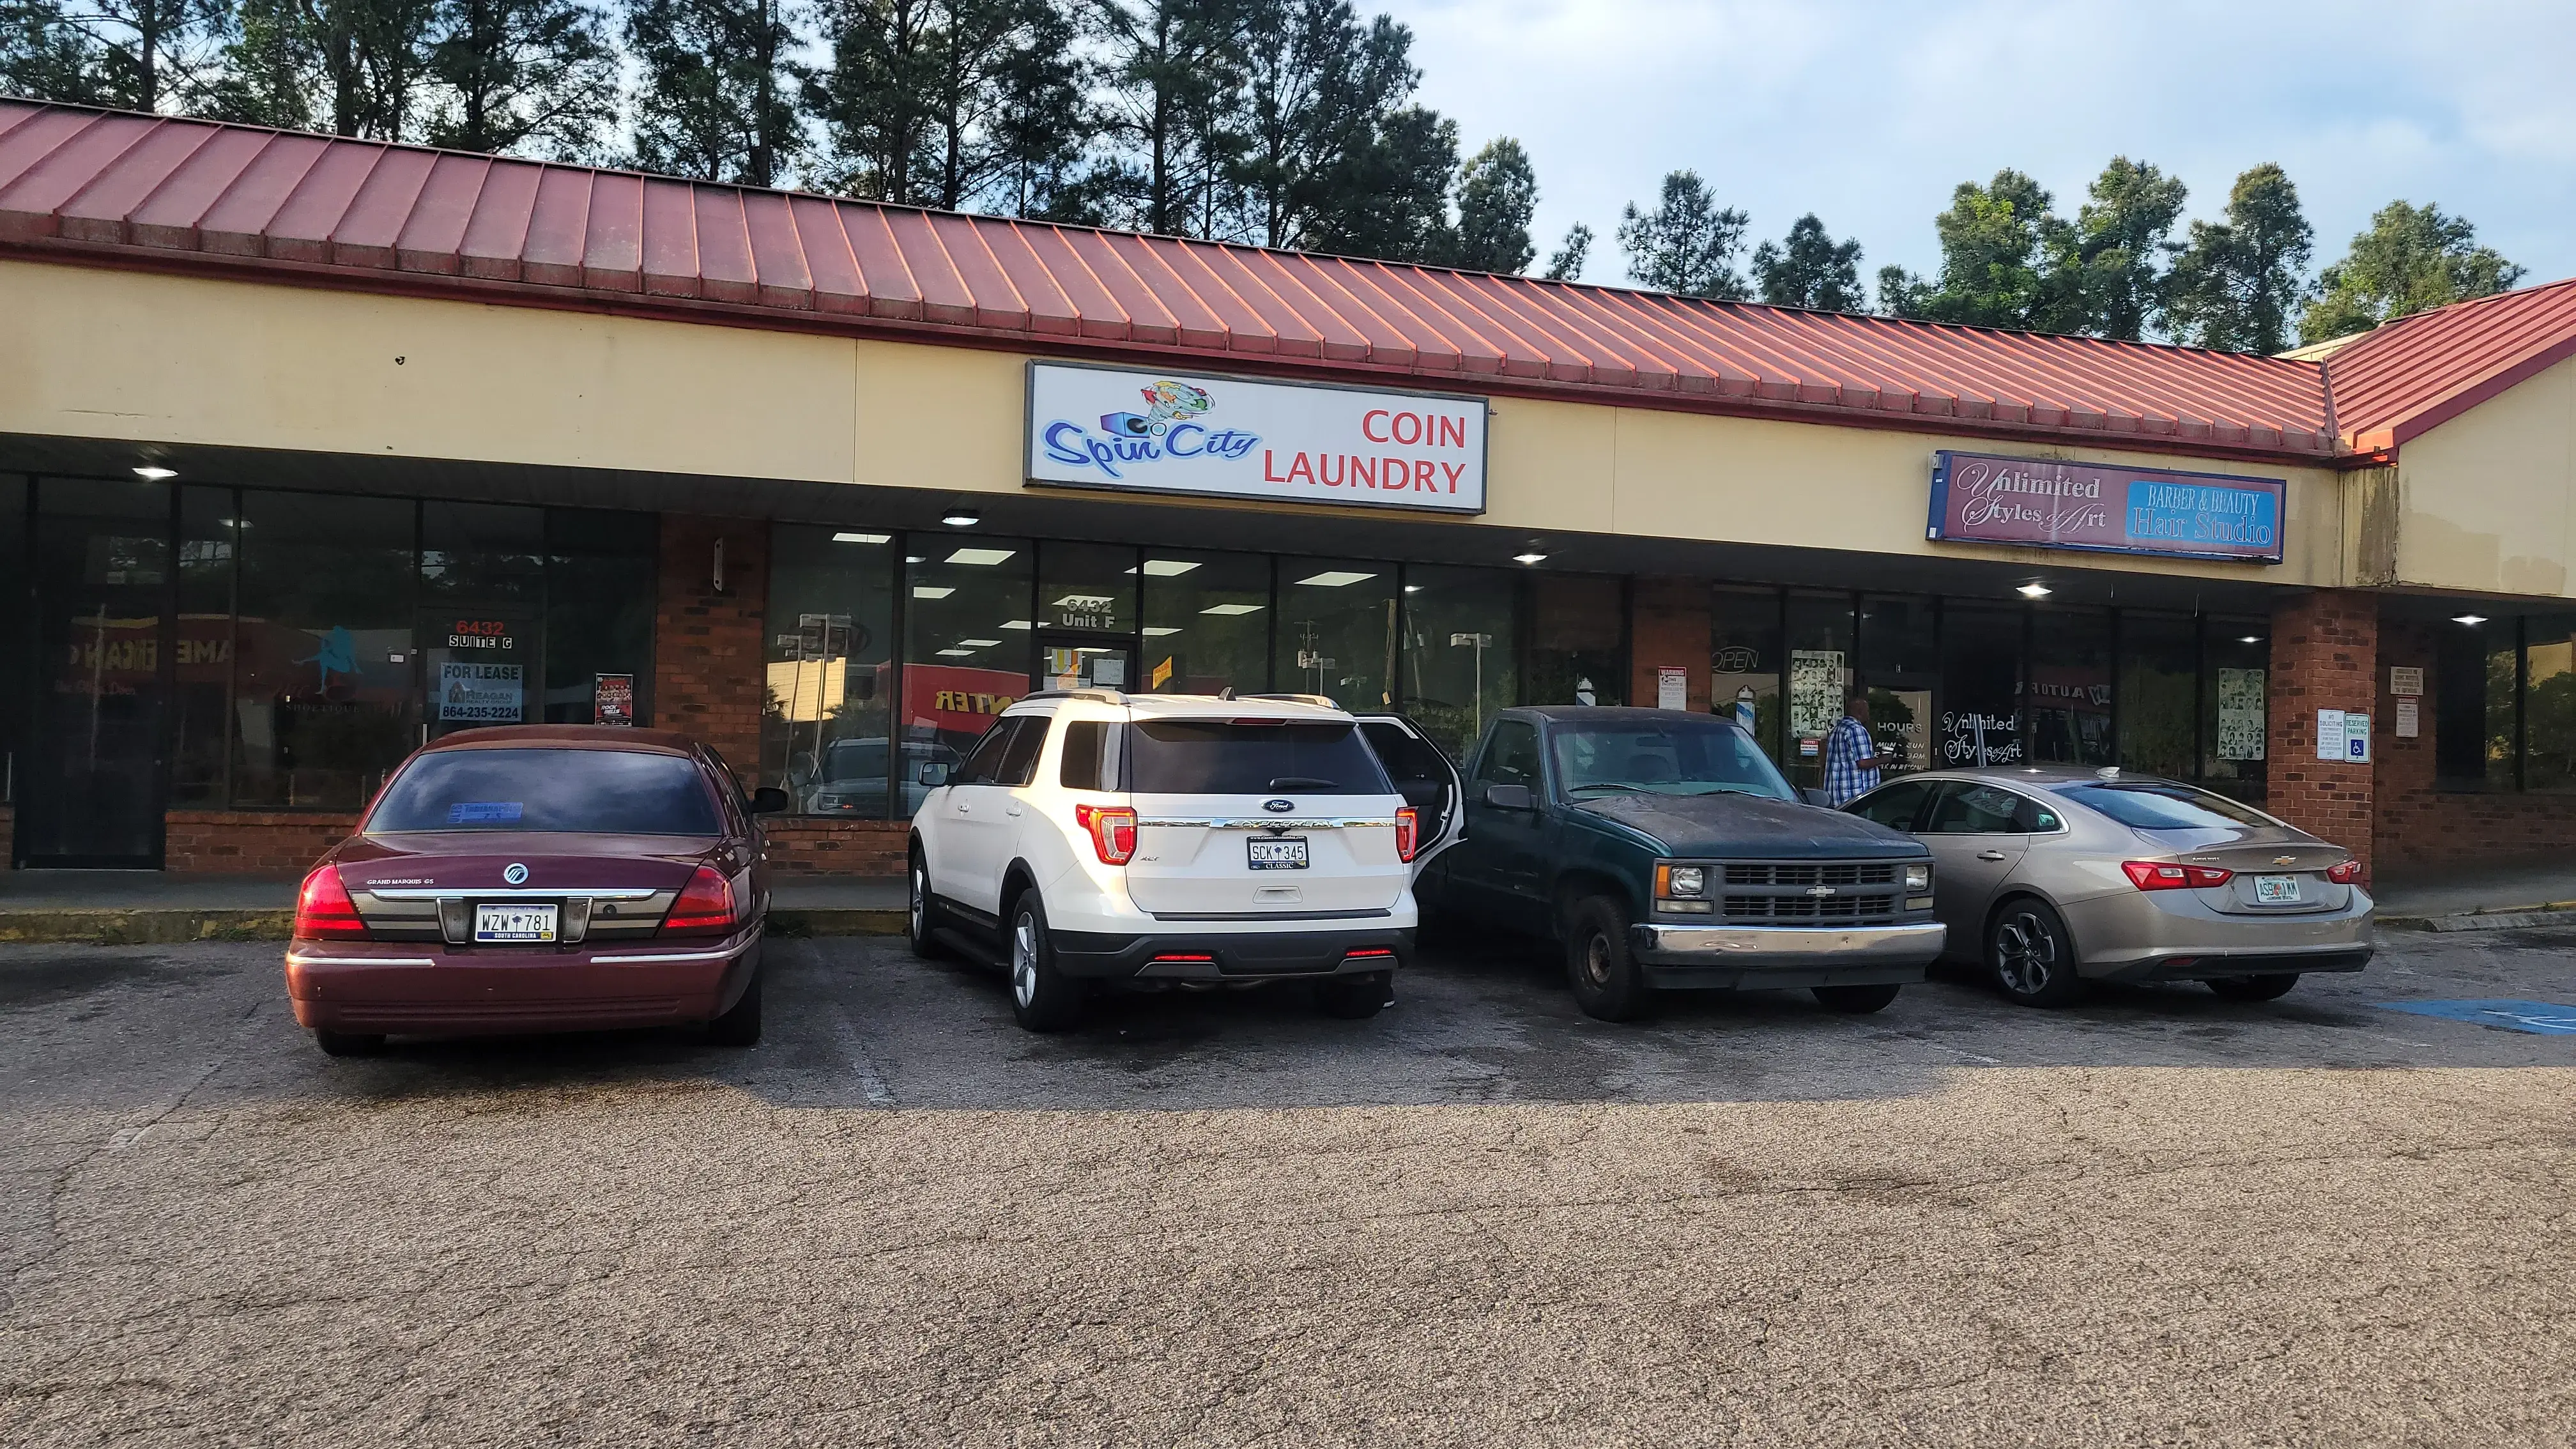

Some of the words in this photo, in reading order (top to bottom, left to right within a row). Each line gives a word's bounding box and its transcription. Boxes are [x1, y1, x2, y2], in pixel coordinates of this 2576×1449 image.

[1362, 410, 1465, 448] COIN
[1045, 422, 1160, 477] Spin
[1165, 424, 1258, 458] City
[1264, 449, 1466, 494] LAUNDRY
[1957, 463, 2101, 501] Unlimited
[2148, 485, 2196, 510] BARBER
[2198, 489, 2208, 511] &
[2211, 490, 2259, 516] BEAUTY
[1961, 494, 2043, 532] Styles
[2133, 507, 2188, 537] Hair
[2195, 512, 2271, 544] Studio
[1067, 599, 1112, 613] 6432
[456, 620, 505, 635] 6432
[1062, 613, 1097, 628] Unit
[1105, 616, 1115, 629] F
[450, 636, 495, 648] SUITE
[503, 638, 512, 648] G
[1712, 652, 1759, 668] OPEN
[444, 666, 471, 678] FOR
[476, 666, 519, 680] LEASE
[466, 690, 512, 700] REAGAN
[443, 707, 518, 718] 864-235-2224
[1877, 722, 1922, 732] HOURS
[1945, 733, 1993, 764] Stys
[1269, 801, 1288, 809] Ford
[1253, 845, 1273, 860] SCK
[1284, 845, 1303, 860] 345
[482, 914, 509, 931] WZW
[525, 914, 550, 931] 781
